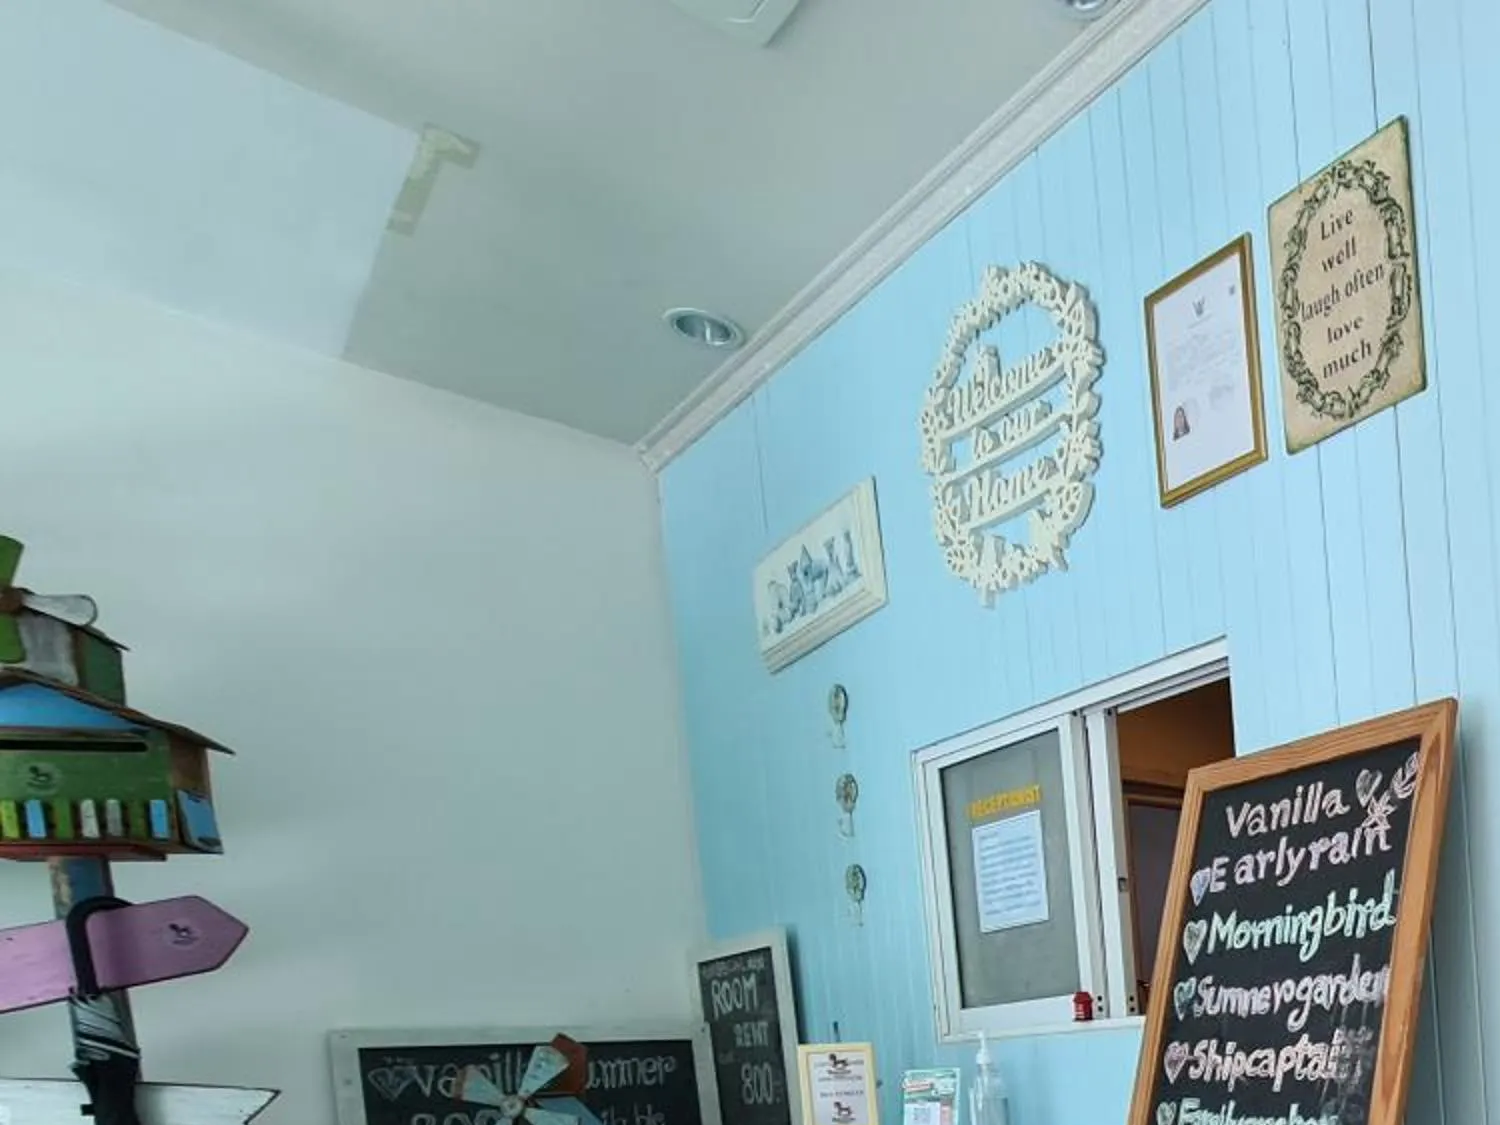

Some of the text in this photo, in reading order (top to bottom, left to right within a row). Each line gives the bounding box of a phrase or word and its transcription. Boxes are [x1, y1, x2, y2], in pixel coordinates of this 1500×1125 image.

[1320, 207, 1354, 241] Live
[1321, 236, 1357, 273] well
[1301, 263, 1385, 323] laugh often
[1326, 313, 1364, 345] love
[1322, 339, 1372, 379] much
[1225, 781, 1351, 838] Vanilla
[1207, 868, 1397, 962] Morningbird
[711, 972, 759, 1021] ROOM
